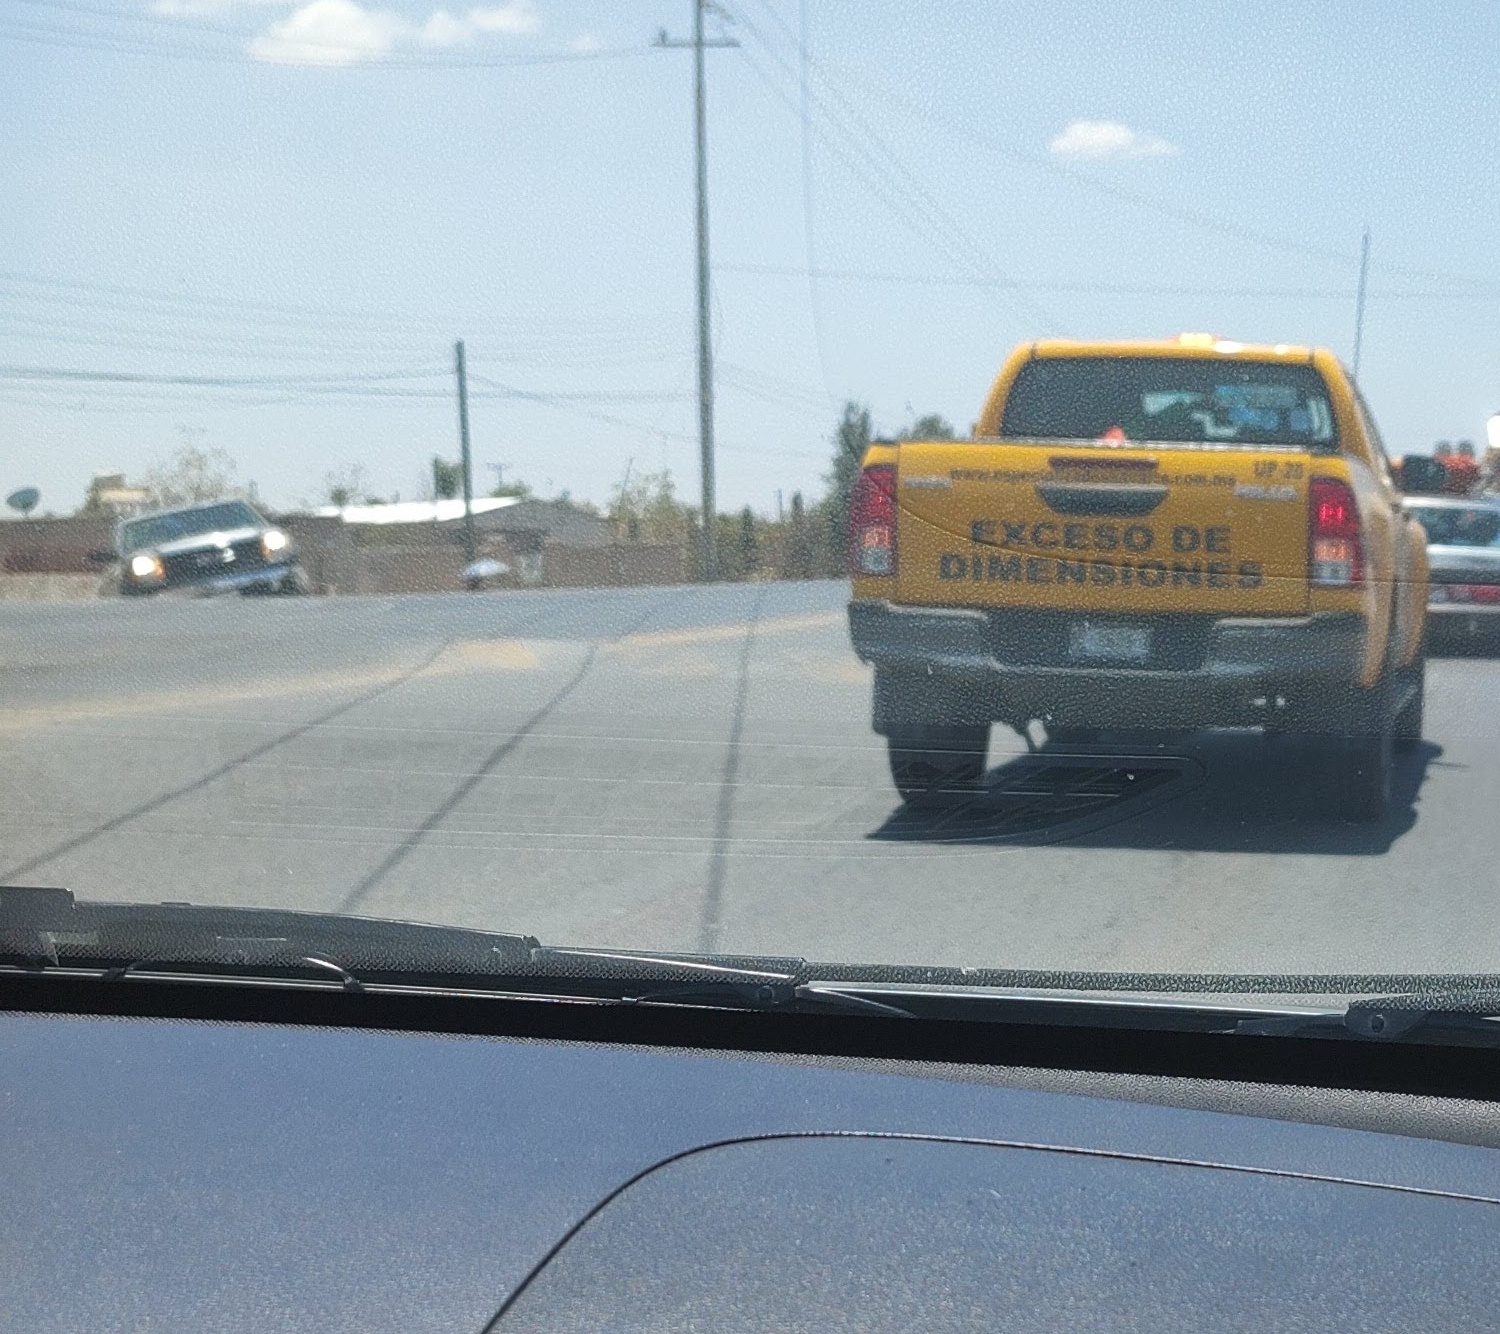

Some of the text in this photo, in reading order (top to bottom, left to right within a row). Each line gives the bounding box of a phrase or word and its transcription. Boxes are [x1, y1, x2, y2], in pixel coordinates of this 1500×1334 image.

[970, 519, 1231, 553] EXCESO DE
[939, 553, 1264, 589] DIMENSIONES
